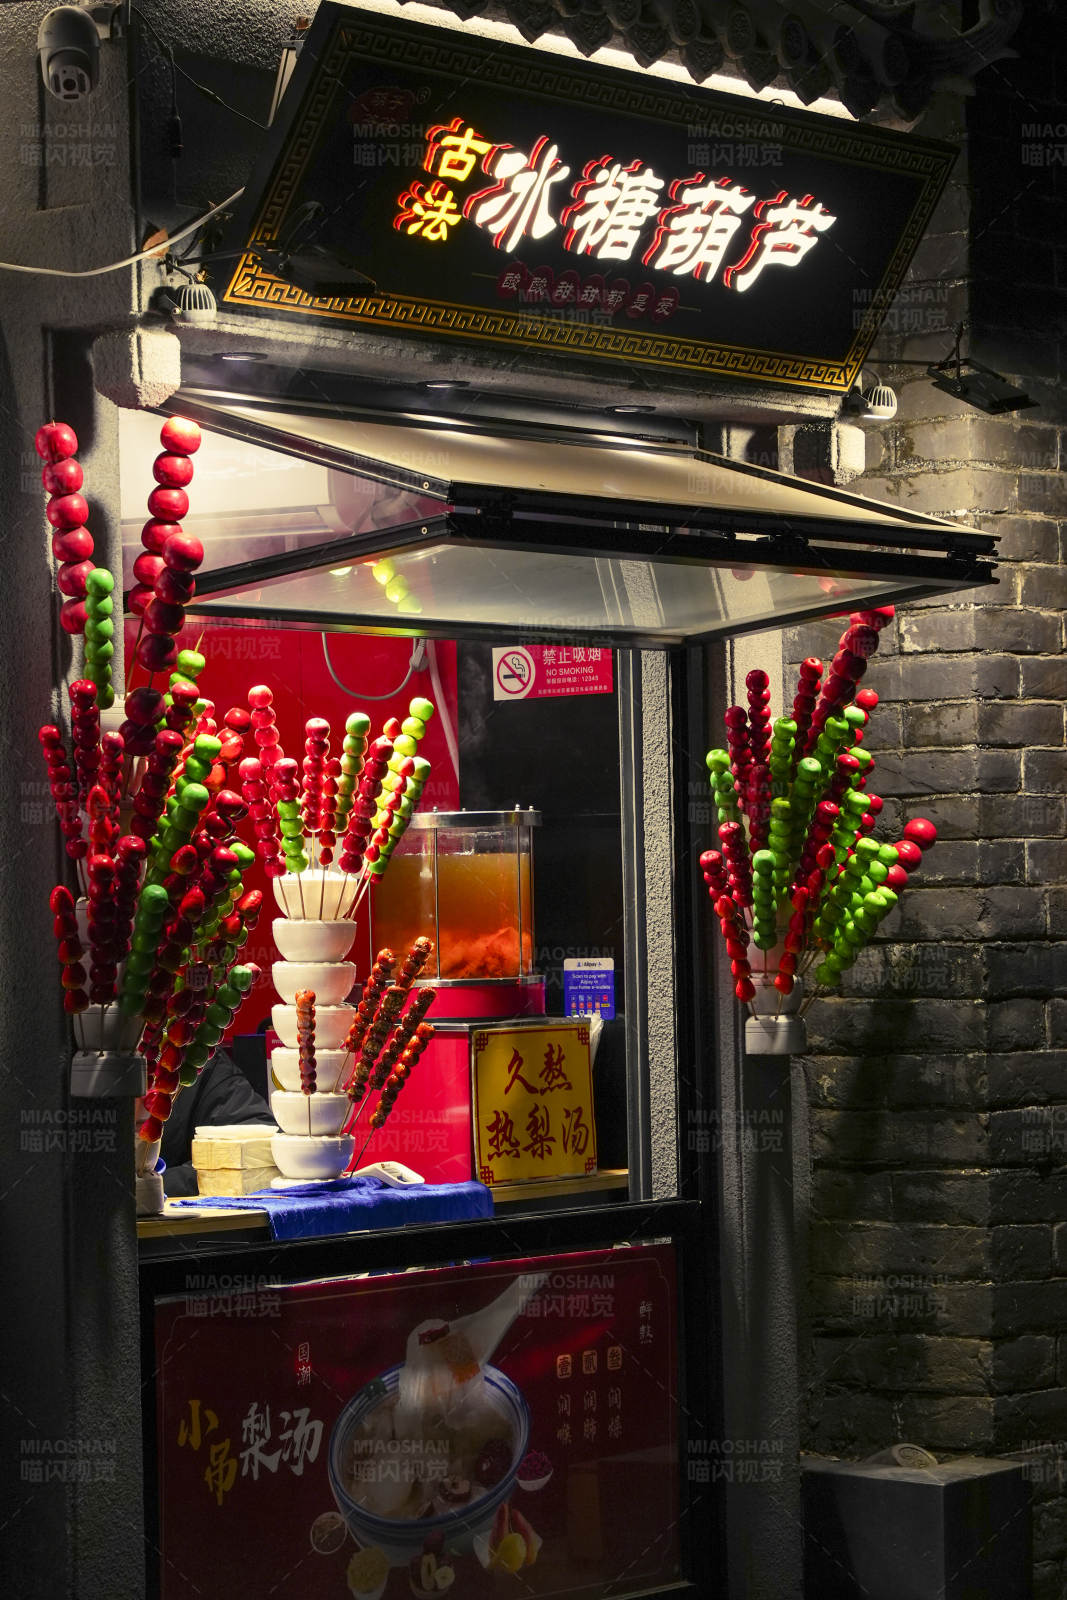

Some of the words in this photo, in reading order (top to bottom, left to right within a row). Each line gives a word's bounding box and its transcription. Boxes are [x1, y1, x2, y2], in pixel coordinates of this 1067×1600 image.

[406, 127, 493, 242] 古法
[474, 143, 838, 293] 冰糖葫芦
[501, 272, 675, 317] 酸酸甜甜都是爱
[543, 647, 601, 666] 禁止吸烟
[546, 668, 557, 676] NO
[559, 666, 594, 676] SMOKING
[504, 1043, 573, 1096] 久熬
[486, 1103, 589, 1162] 热梨汤
[297, 1341, 312, 1385] 国潮
